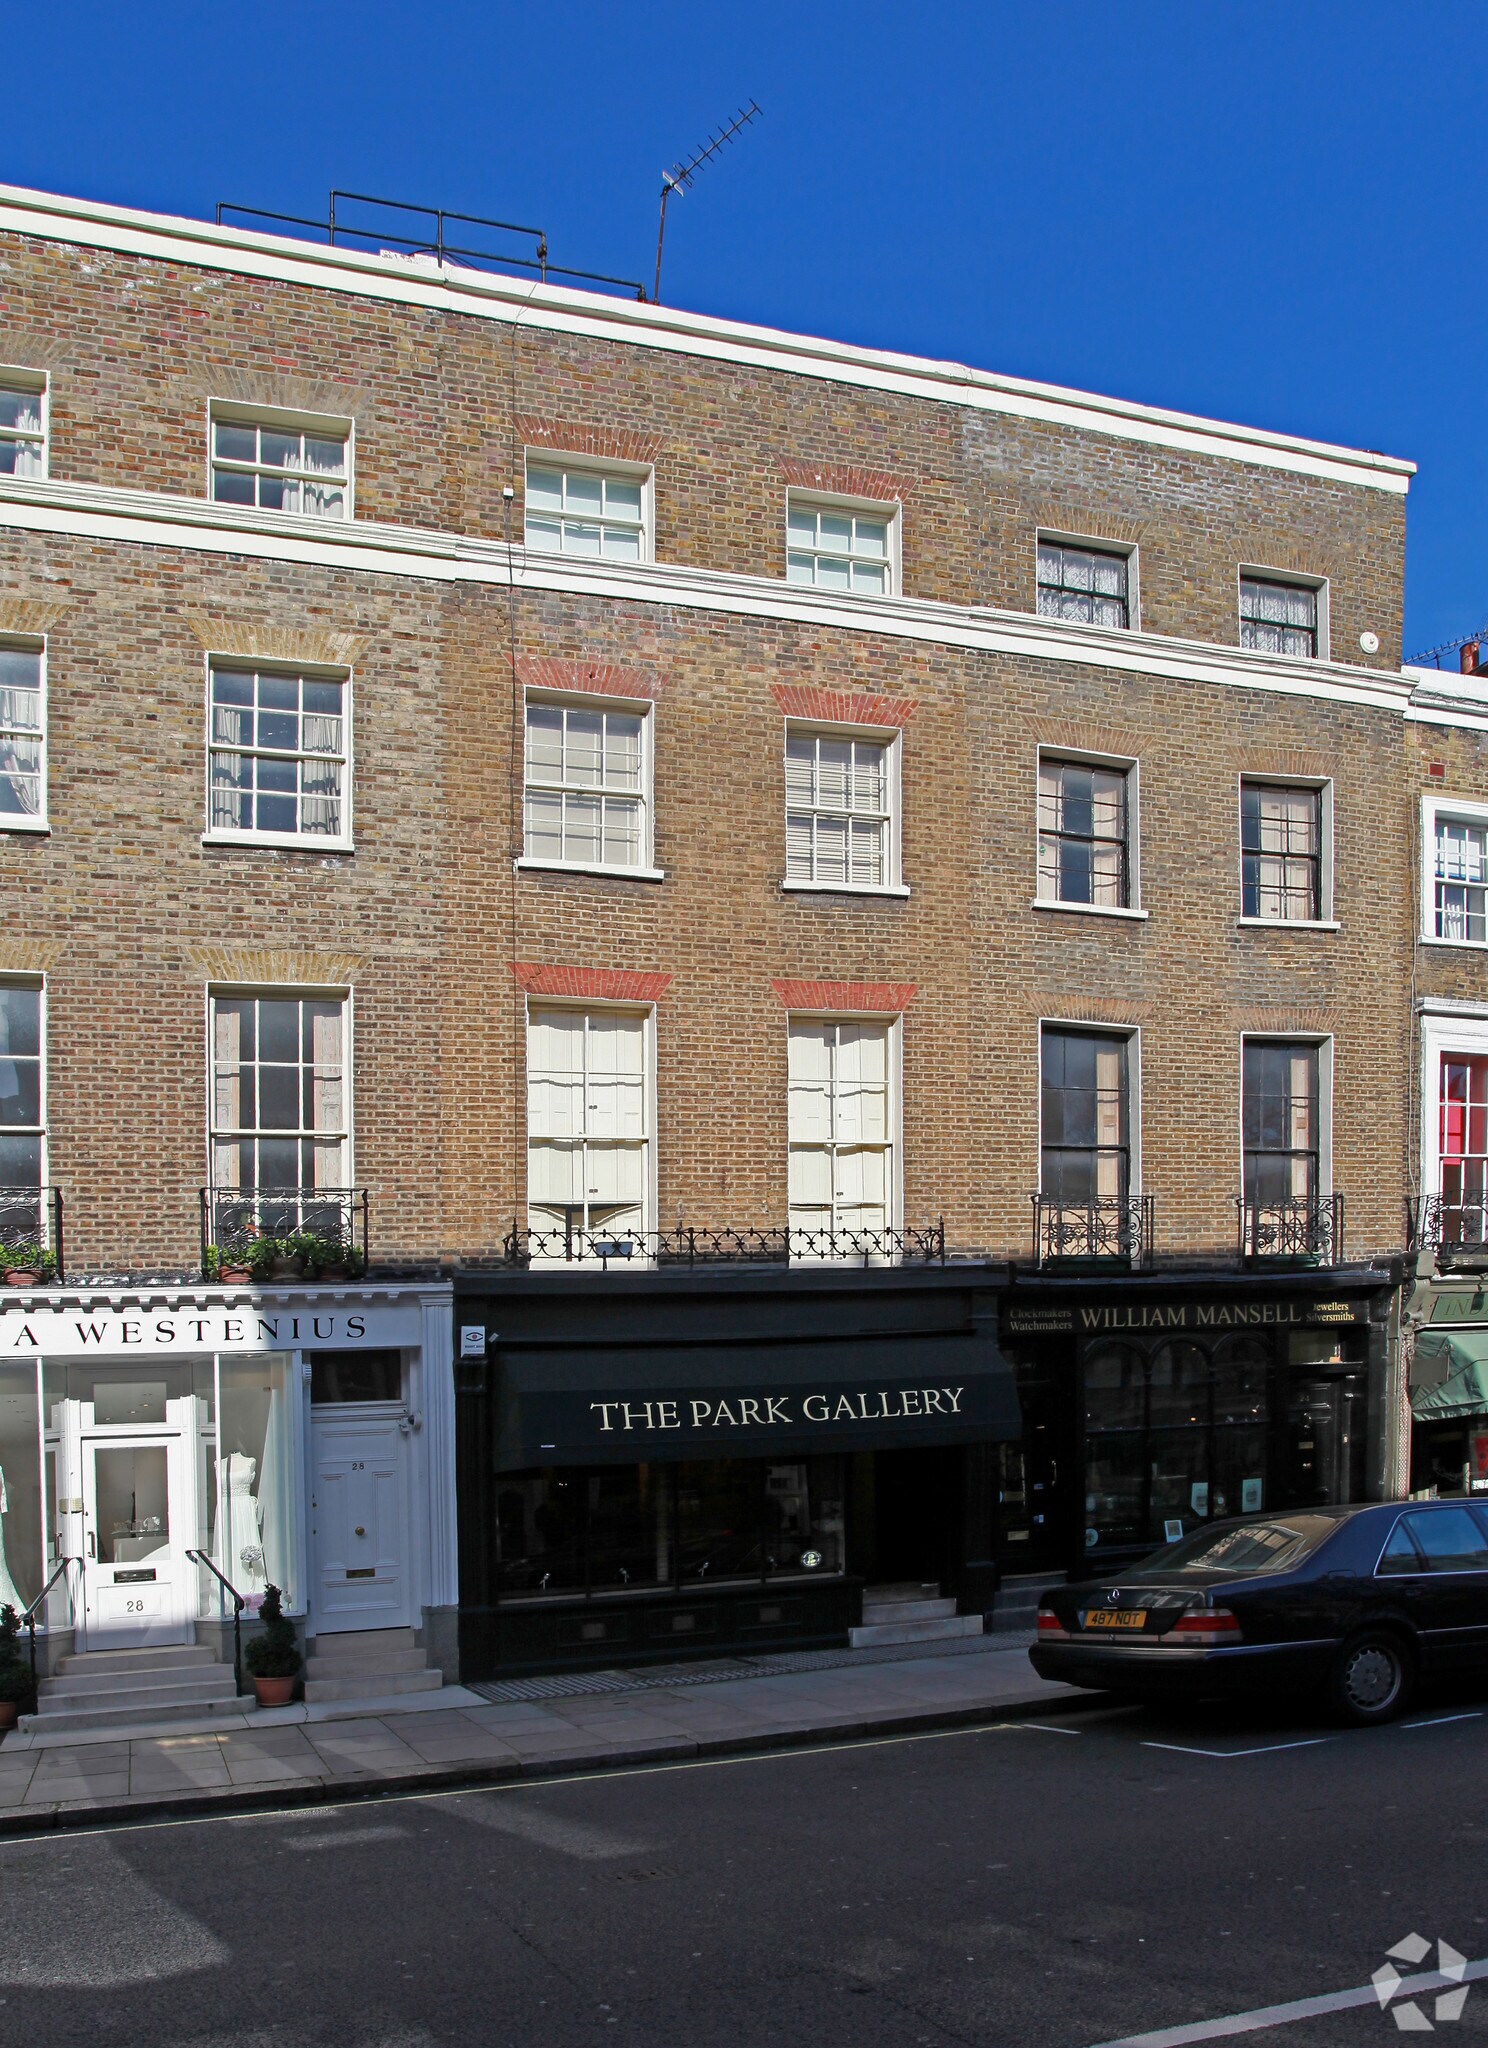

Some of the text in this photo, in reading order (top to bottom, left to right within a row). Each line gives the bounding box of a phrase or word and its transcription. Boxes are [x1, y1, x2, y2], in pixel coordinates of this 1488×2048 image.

[1313, 1301, 1349, 1311] Jewellers
[1009, 1307, 1072, 1319] Clockmakers
[1080, 1304, 1301, 1328] WILLIAM MANSELL
[1306, 1311, 1355, 1322] Silversmiths
[75, 1316, 366, 1344] WESTENIUS
[1009, 1319, 1072, 1331] Watchmakers
[590, 1387, 964, 1431] THE PARK GALLERY
[352, 1462, 364, 1471] 28
[126, 1600, 144, 1613] 28
[1091, 1612, 1140, 1625] 487 NOT
